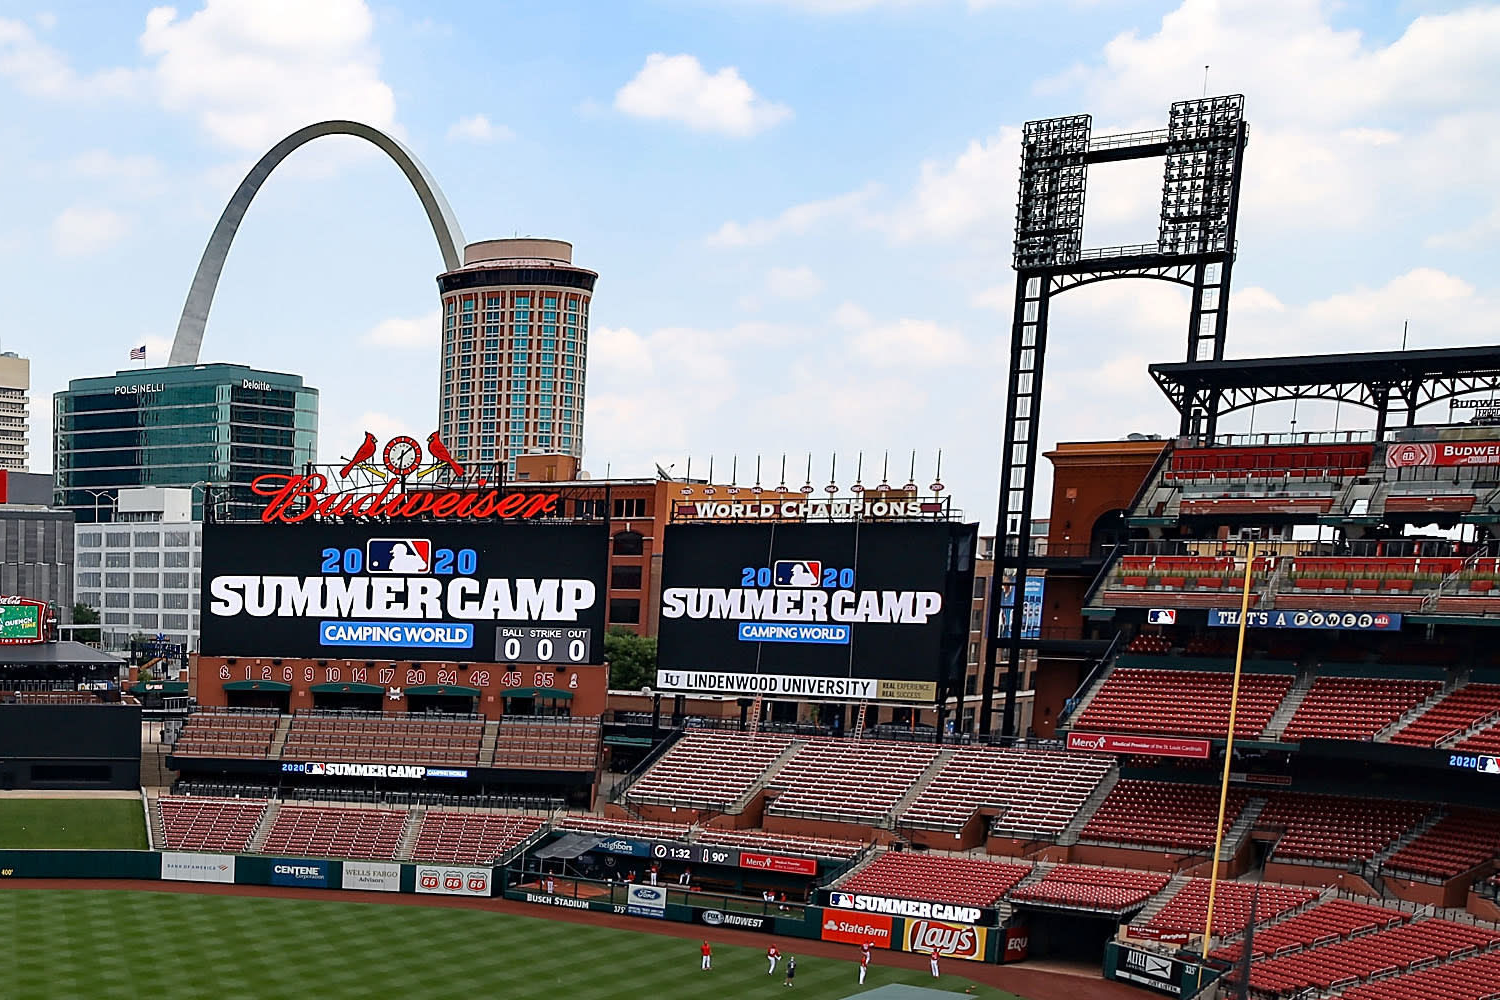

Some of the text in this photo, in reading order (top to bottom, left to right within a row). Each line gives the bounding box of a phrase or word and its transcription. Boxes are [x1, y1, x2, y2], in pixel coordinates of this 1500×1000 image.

[115, 383, 164, 395] POLSINELLI
[251, 473, 560, 523] Budweiser
[695, 500, 922, 518] WORLD CHAMPIONS
[321, 548, 477, 575] 20 20
[742, 568, 854, 588] 20 20
[210, 575, 596, 621] SUMMER CAMP
[663, 588, 942, 623] SUMMER CAMP
[5, 617, 33, 627] QUENCH
[1218, 612, 1287, 625] THAT'S A
[324, 625, 468, 643] CAMPING WORLD
[502, 629, 587, 638] BALL STRIKE OUT
[742, 626, 845, 640] CAMPING WORLD
[503, 638, 585, 661] 0 0 0
[245, 667, 554, 688] 1 2 6 9 10 14 17 20 24 42 45 85
[664, 673, 871, 696] LU LINDENWOOD UNIVERSITY
[1071, 737, 1099, 749] Mercy
[1450, 755, 1477, 768] 2020
[282, 763, 426, 778] 2020 SUMMER CAMP
[598, 841, 633, 851] neighbors
[670, 849, 728, 862] 1:32 90°
[746, 857, 767, 868] Mercy
[1, 868, 13, 876] 400'
[274, 865, 319, 876] CENTENE
[422, 878, 437, 886] 66
[638, 888, 656, 899] Ford
[527, 893, 589, 909] BUSCH STADIUM
[707, 912, 719, 920] FOX
[854, 895, 981, 923] SUMMER CAMP
[724, 914, 764, 928] MIDWEST
[913, 920, 973, 954] Lay's
[1127, 950, 1146, 967] ALTEC
[1184, 965, 1197, 975] 335'
